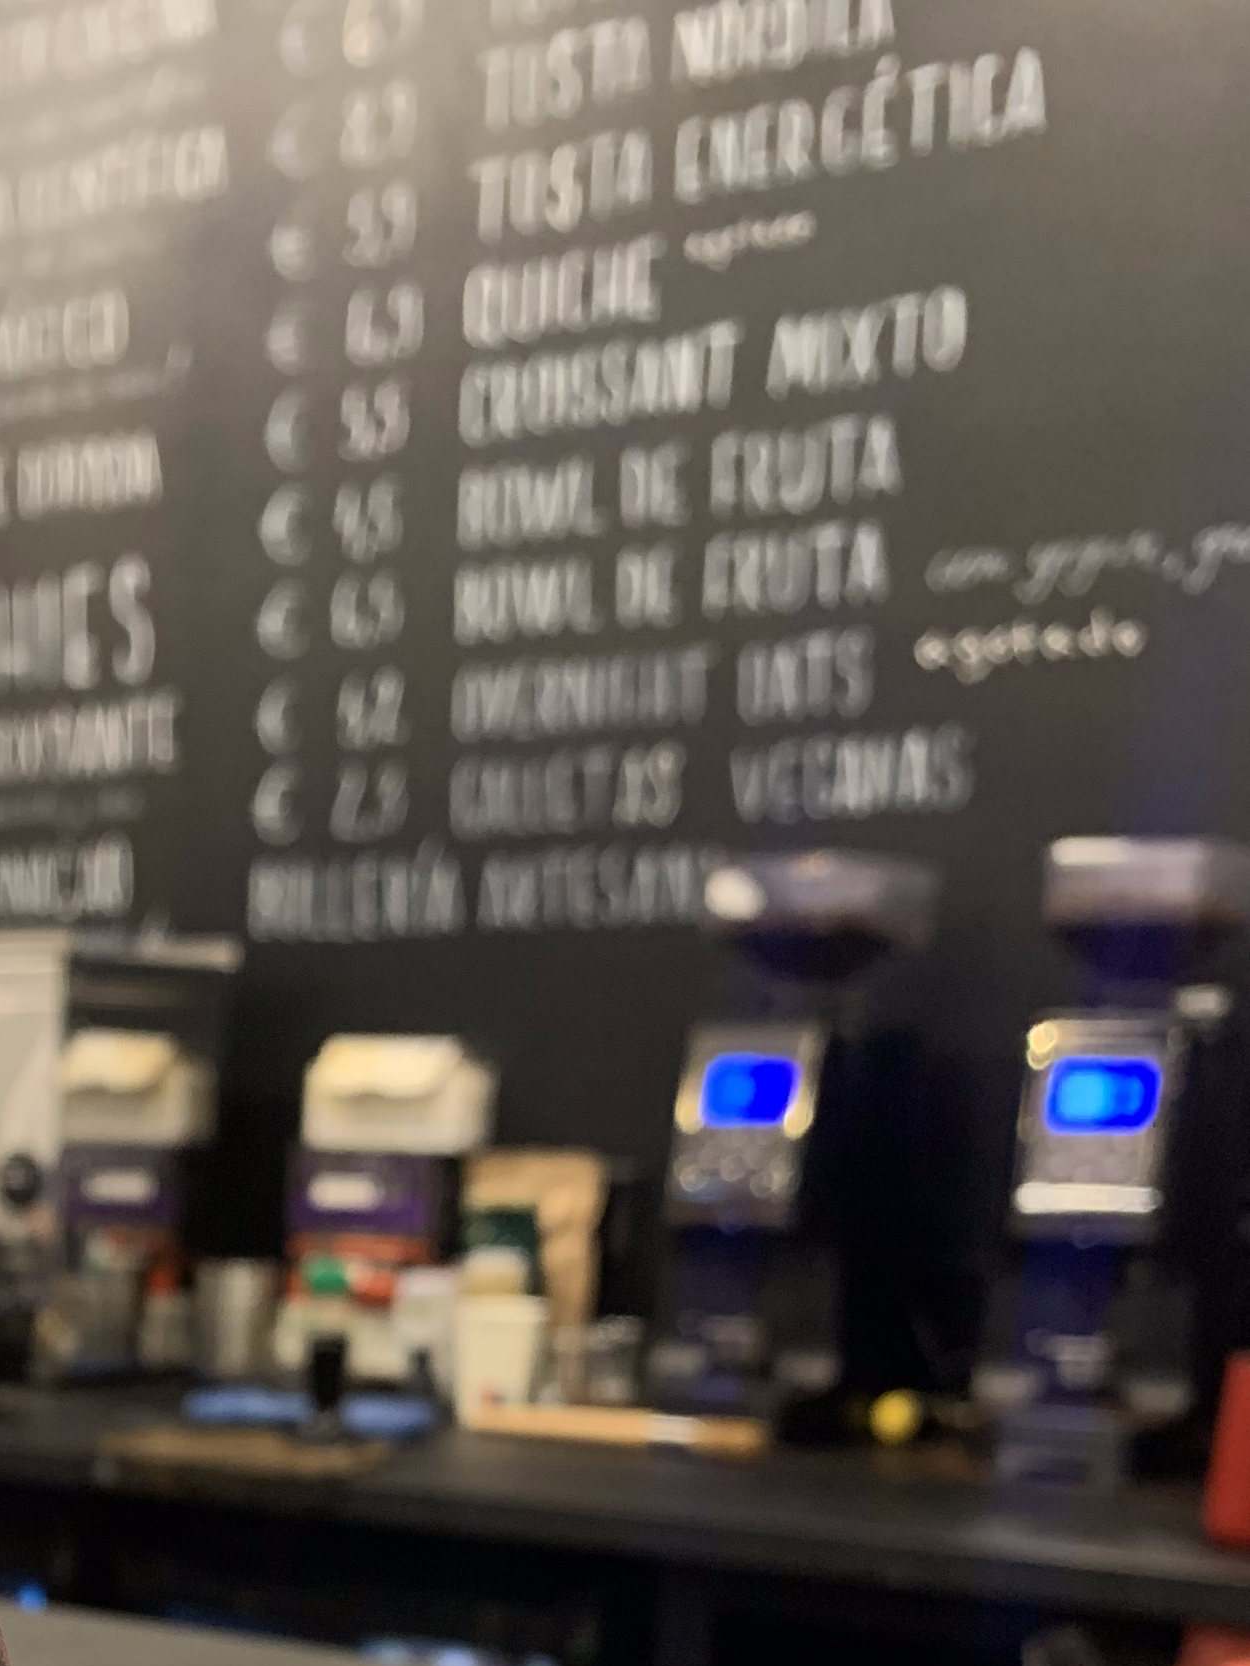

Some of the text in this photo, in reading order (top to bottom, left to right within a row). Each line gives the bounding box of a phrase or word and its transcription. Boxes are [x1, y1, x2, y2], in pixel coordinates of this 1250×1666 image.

[765, 284, 969, 400] MIXTO
[710, 413, 904, 516] FRUTA
[702, 518, 891, 620] FRUTA
[914, 606, 1148, 685] agotado
